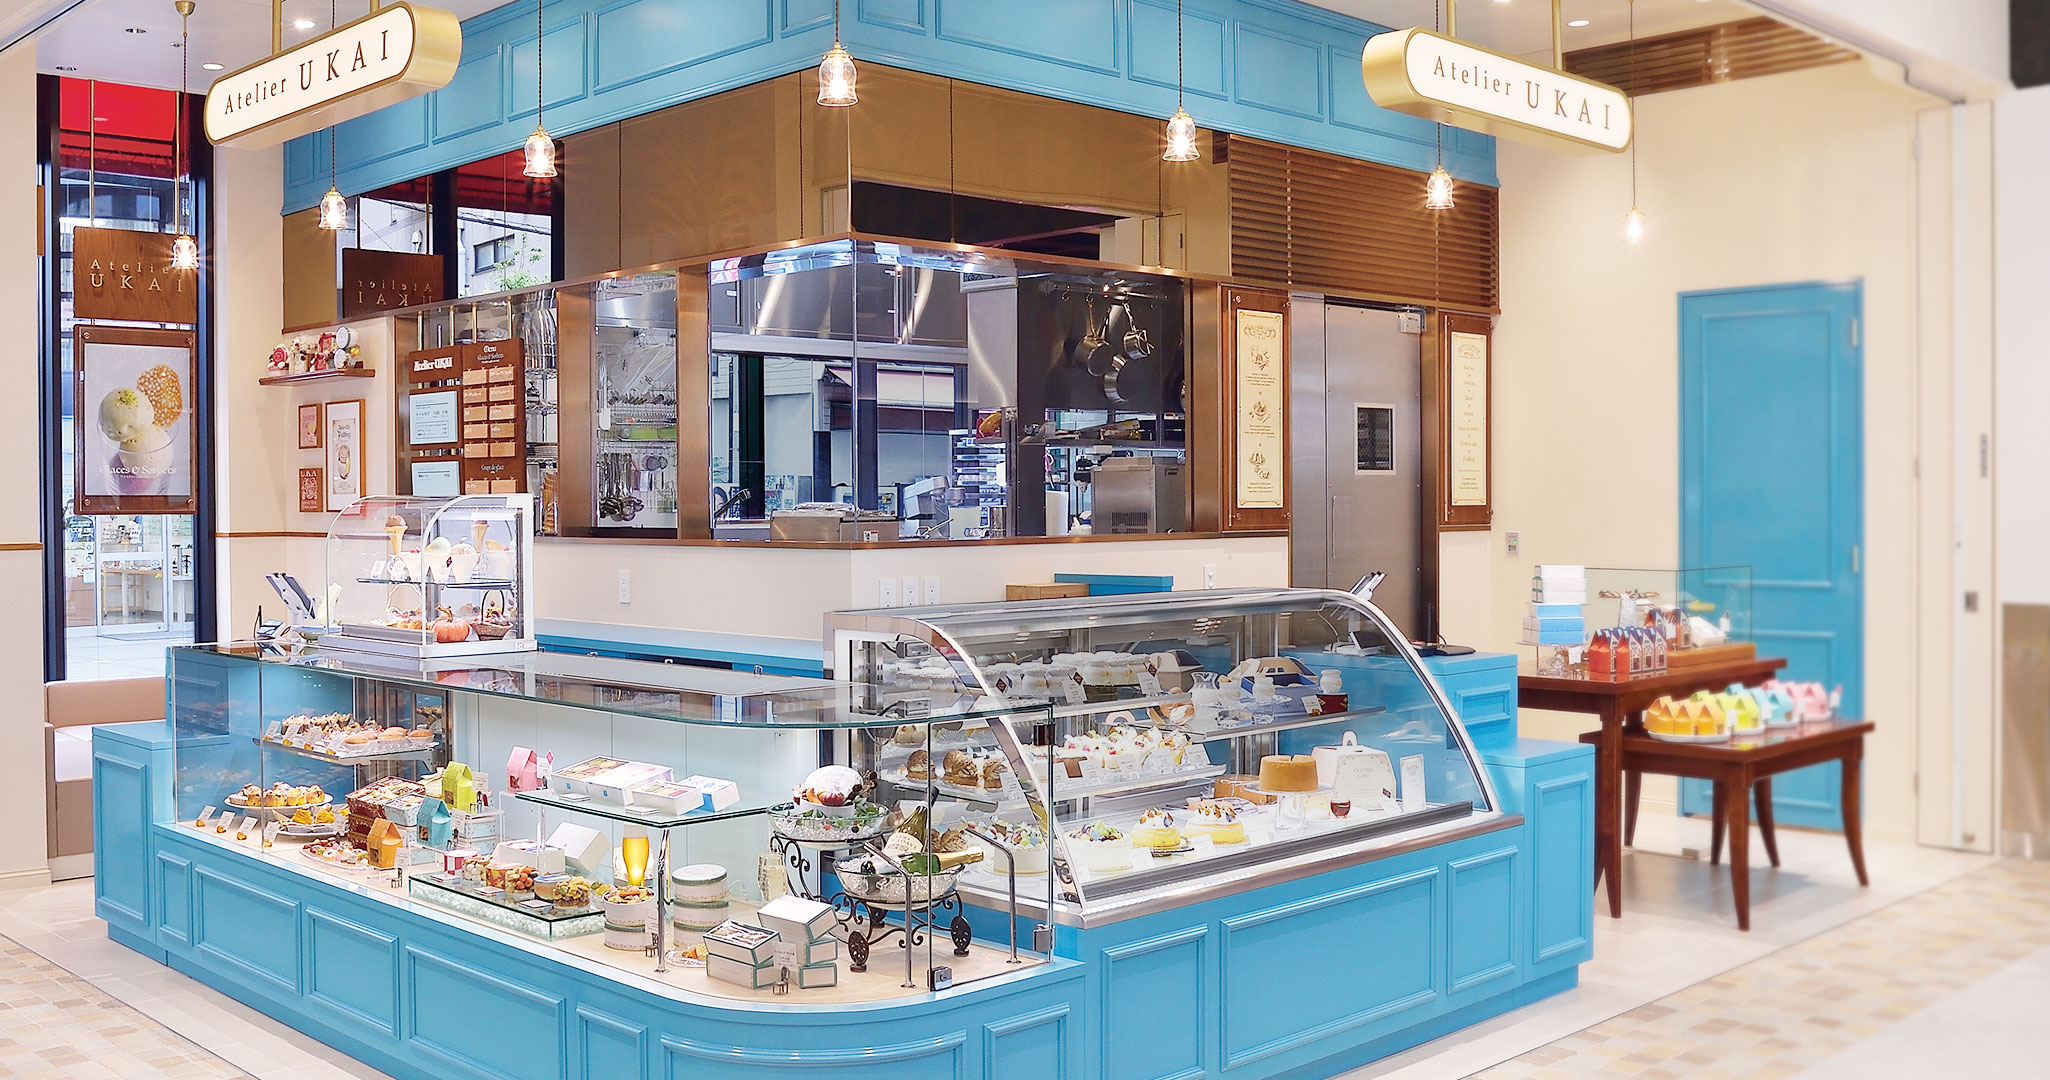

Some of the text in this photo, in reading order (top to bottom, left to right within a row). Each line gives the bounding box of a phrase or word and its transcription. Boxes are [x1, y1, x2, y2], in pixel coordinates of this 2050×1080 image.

[224, 29, 389, 115] Atelier UKAI
[1433, 55, 1610, 130] Atelier UKAI
[90, 272, 183, 292] UKAI
[413, 356, 453, 372] Atelier UKAI
[131, 465, 140, 474] &
